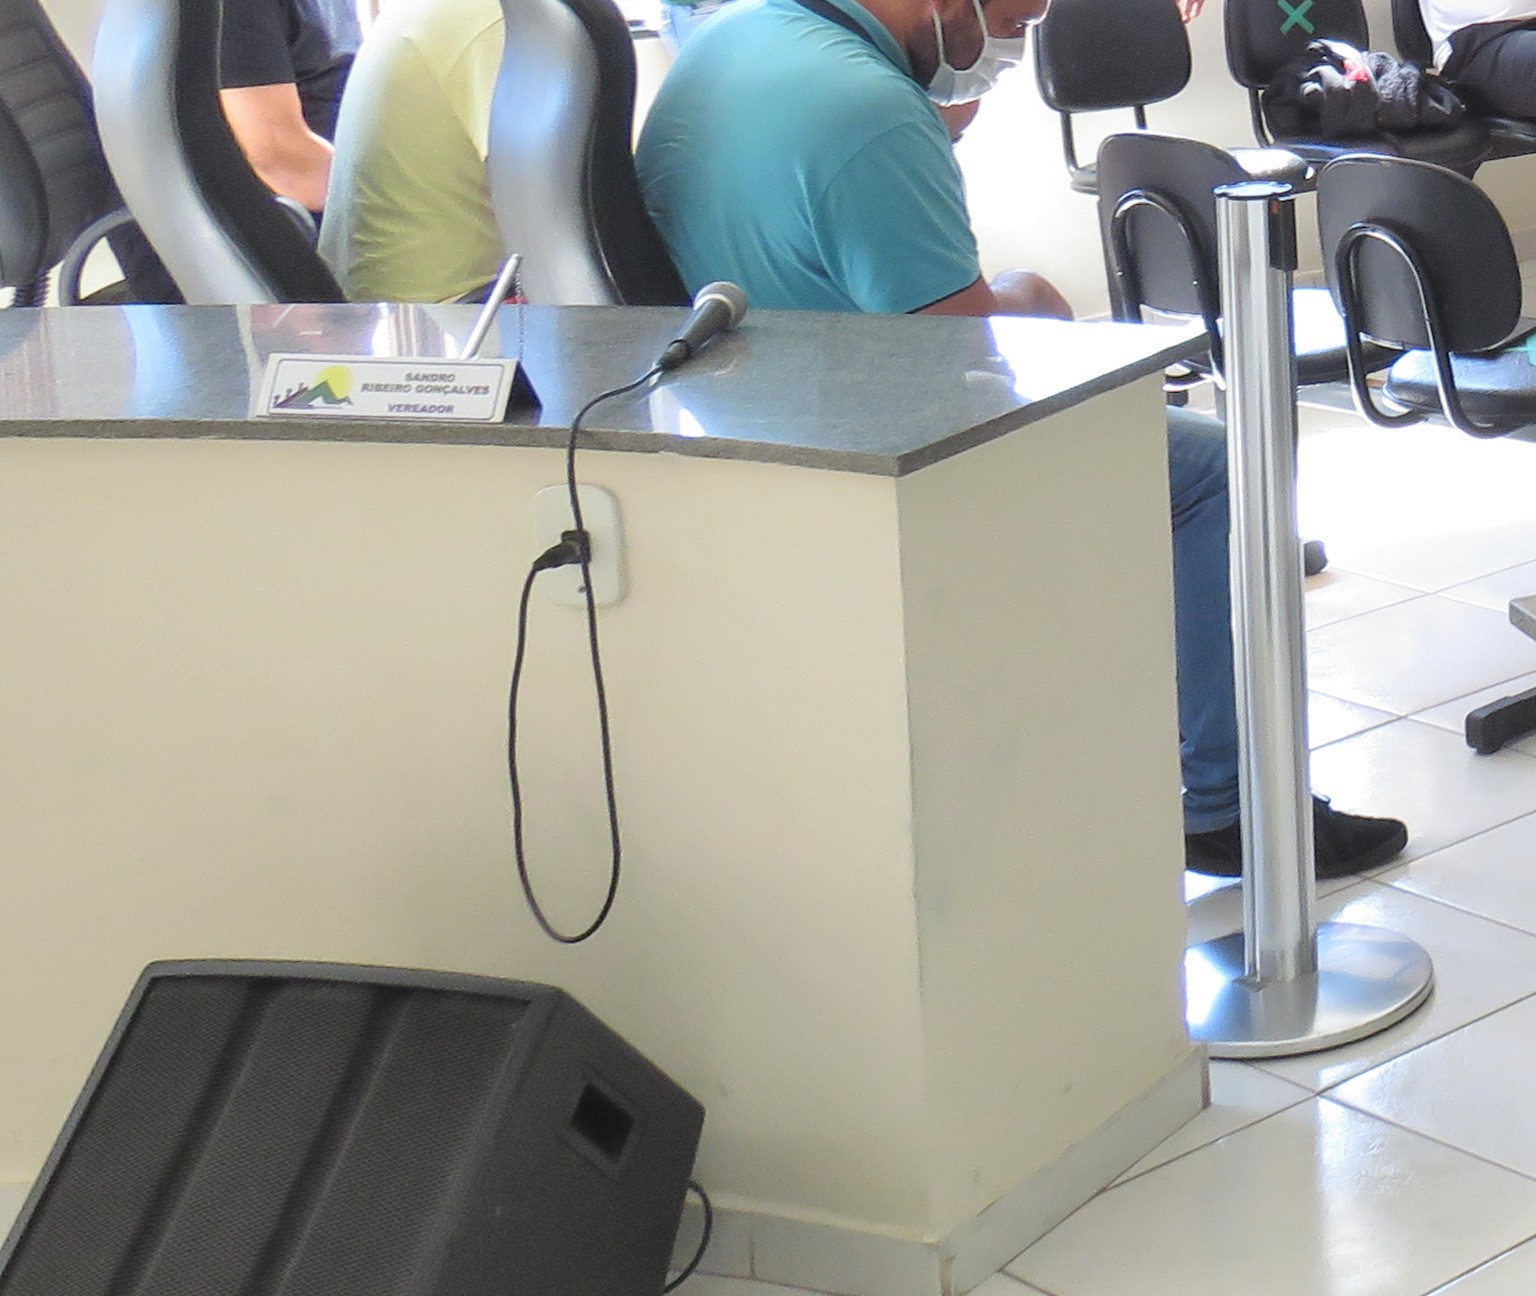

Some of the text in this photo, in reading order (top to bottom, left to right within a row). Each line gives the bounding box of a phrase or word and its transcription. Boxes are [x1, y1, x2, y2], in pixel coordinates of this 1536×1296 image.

[405, 372, 455, 382] SANDRO
[361, 382, 490, 395] RIBEIRO GONÇALVES
[388, 403, 454, 413] VEREADOR
